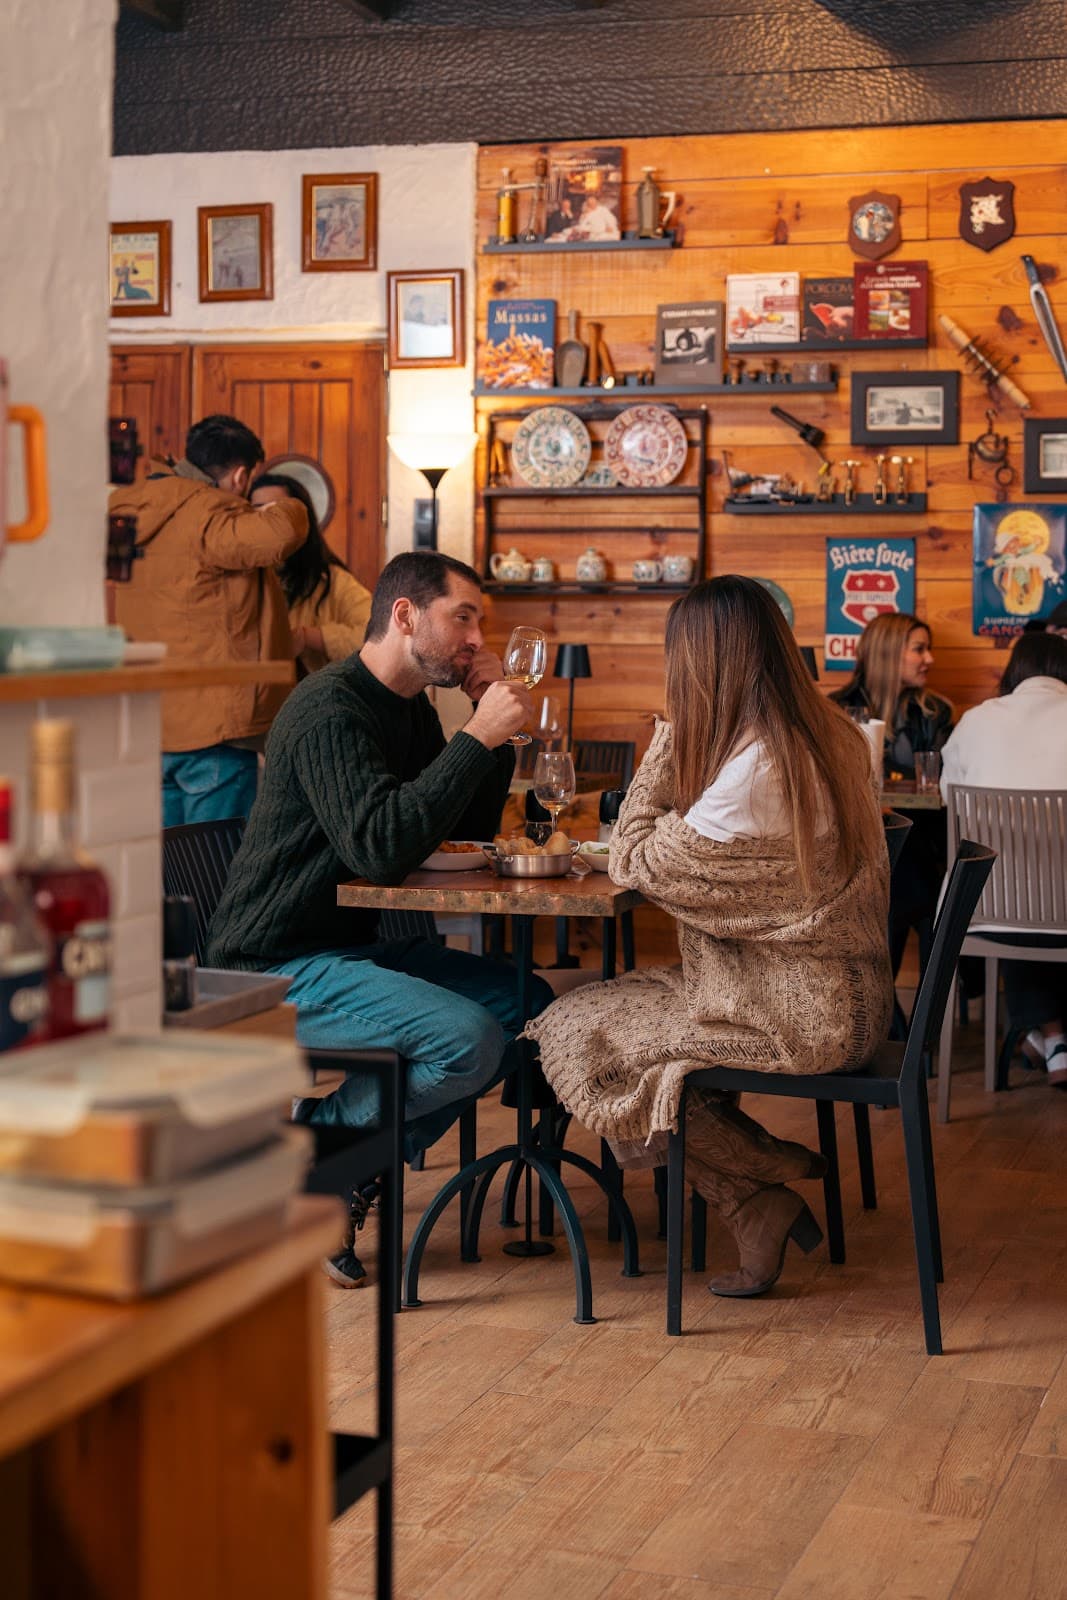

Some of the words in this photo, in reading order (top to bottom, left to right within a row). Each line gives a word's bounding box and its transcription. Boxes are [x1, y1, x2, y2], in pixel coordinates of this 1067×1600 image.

[494, 309, 548, 324] Massas
[875, 542, 914, 572] forte
[978, 623, 1025, 637] GANG
[828, 637, 857, 657] CH
